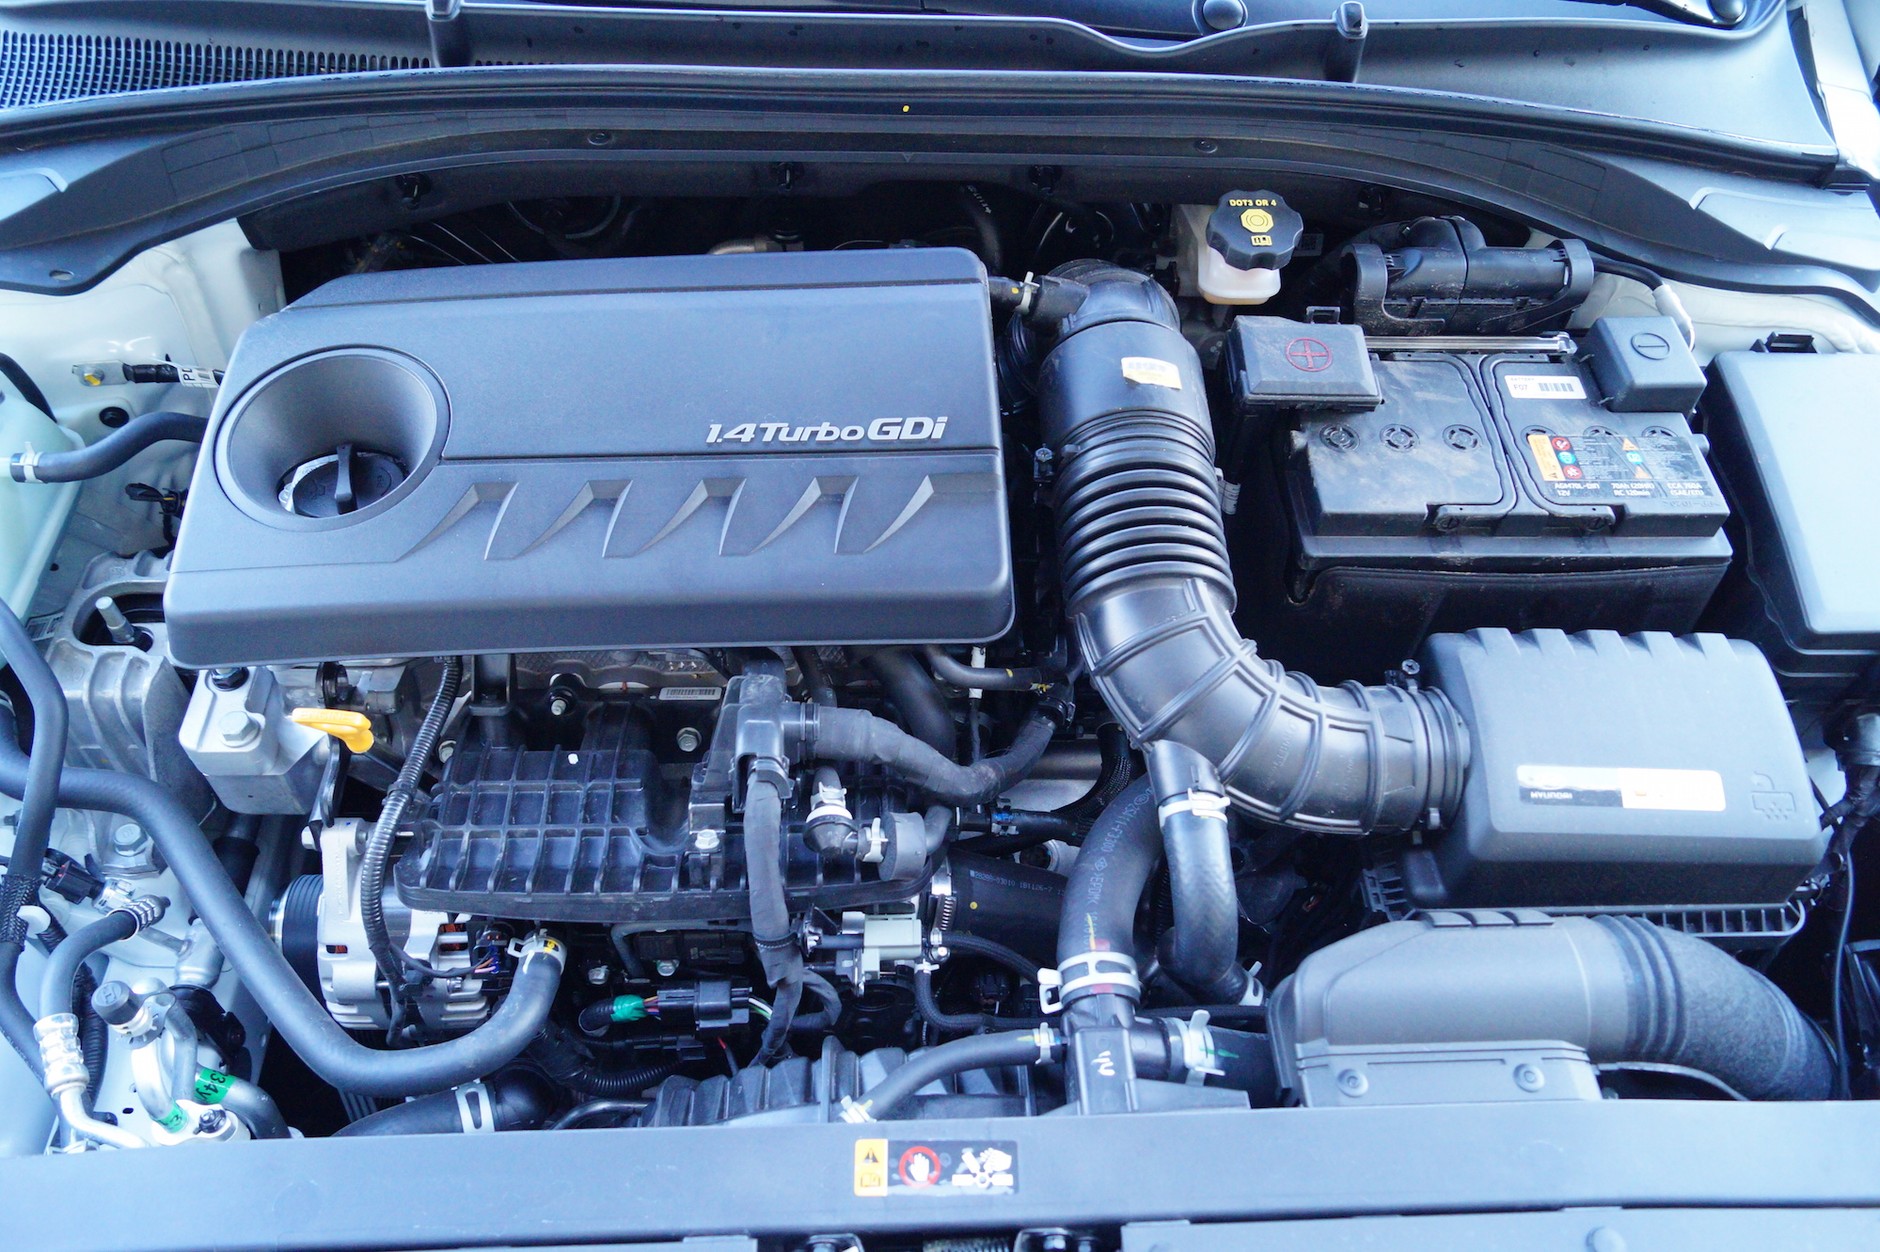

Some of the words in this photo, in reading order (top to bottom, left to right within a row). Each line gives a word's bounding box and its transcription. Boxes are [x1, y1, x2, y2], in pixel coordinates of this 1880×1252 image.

[706, 423, 757, 443] 1.4
[759, 422, 864, 443] Turbo
[867, 416, 948, 441] GDi
